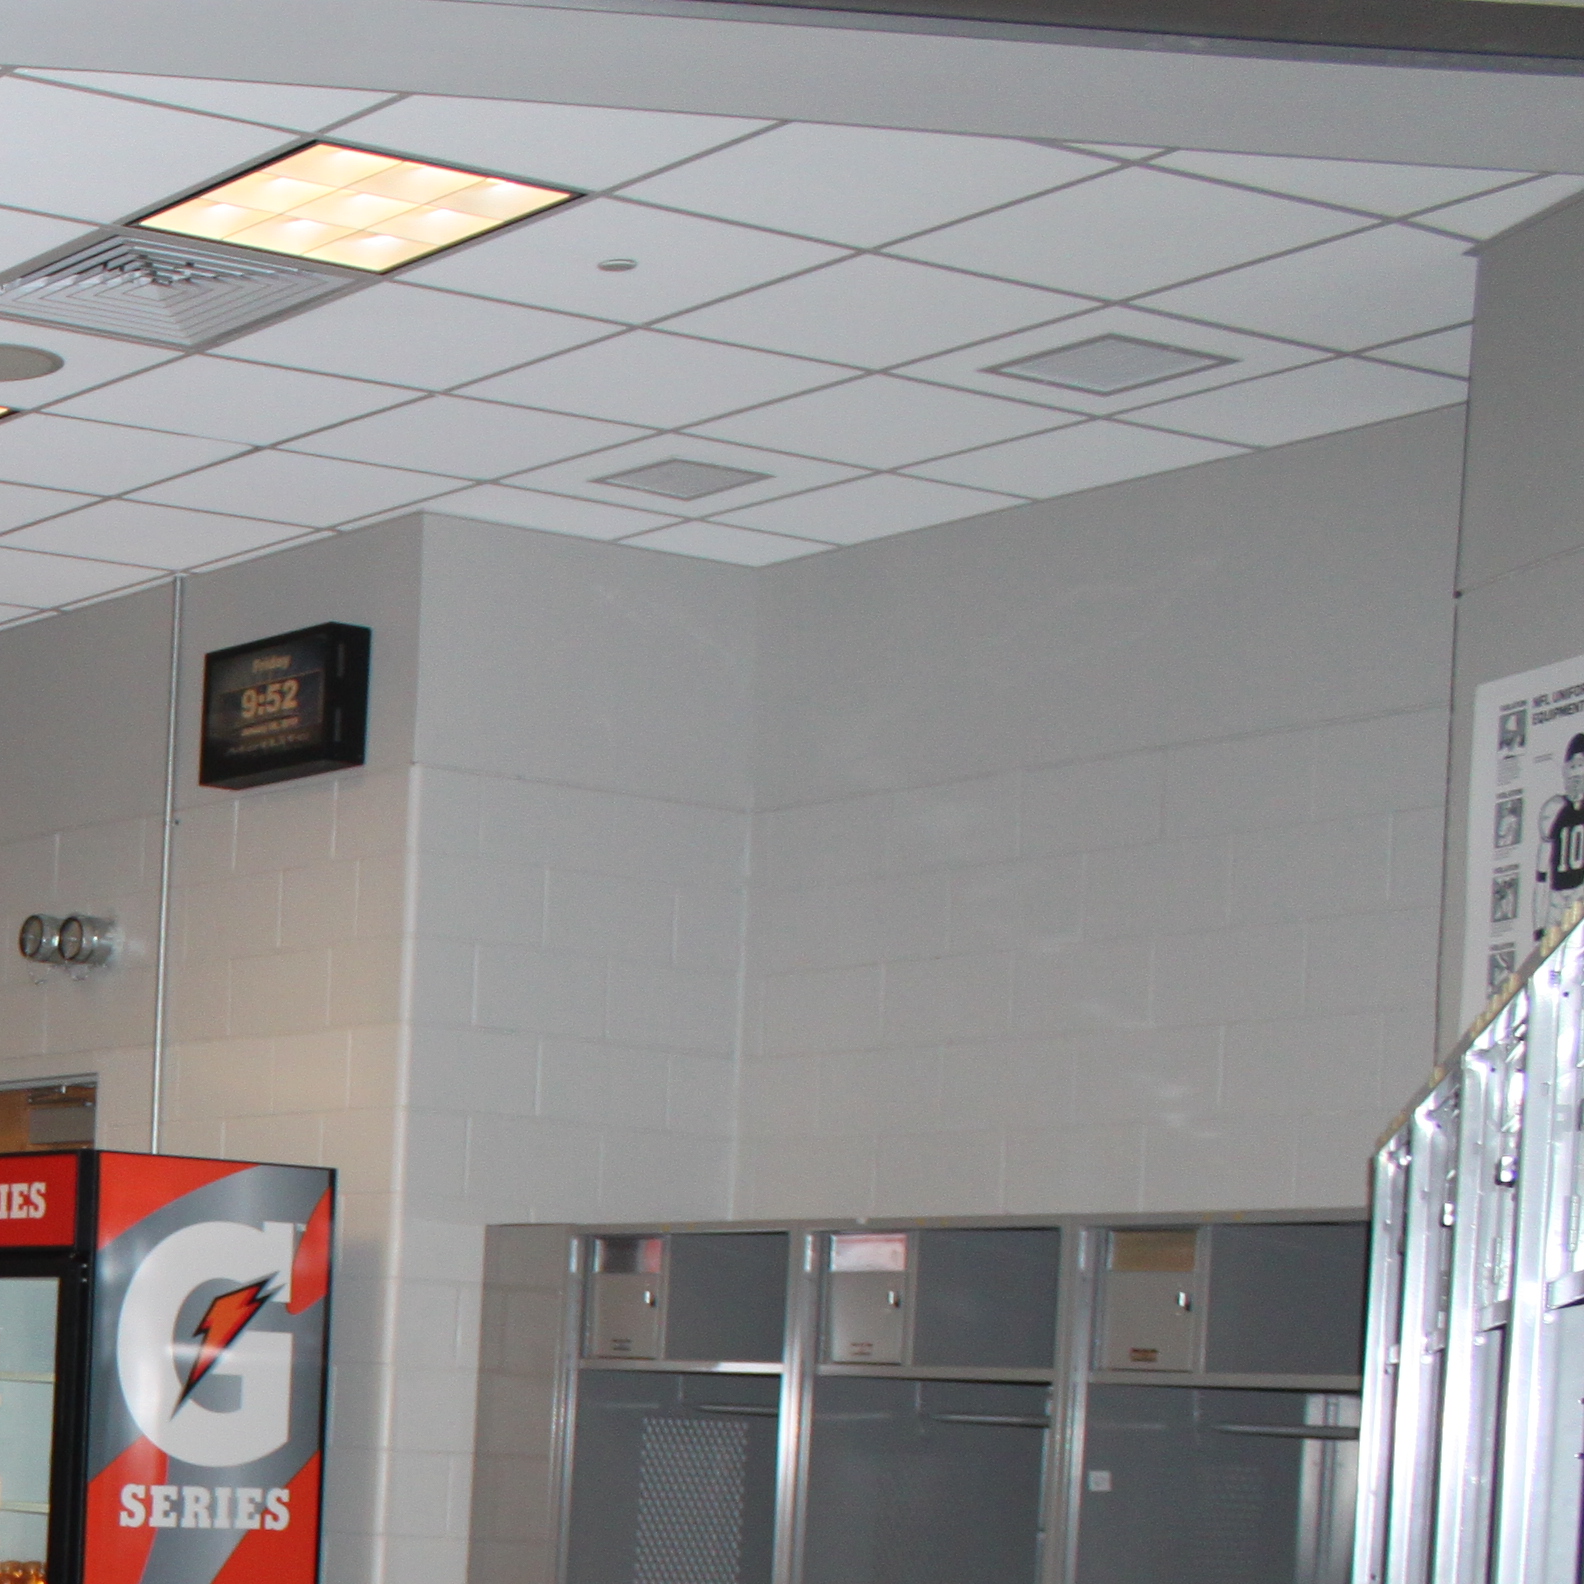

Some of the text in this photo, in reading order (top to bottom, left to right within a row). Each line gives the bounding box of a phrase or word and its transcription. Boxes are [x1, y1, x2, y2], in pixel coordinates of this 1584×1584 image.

[241, 678, 301, 718] 9:52
[1557, 824, 1584, 873] 10
[117, 1221, 293, 1467] G
[119, 1483, 290, 1530] SERIES
